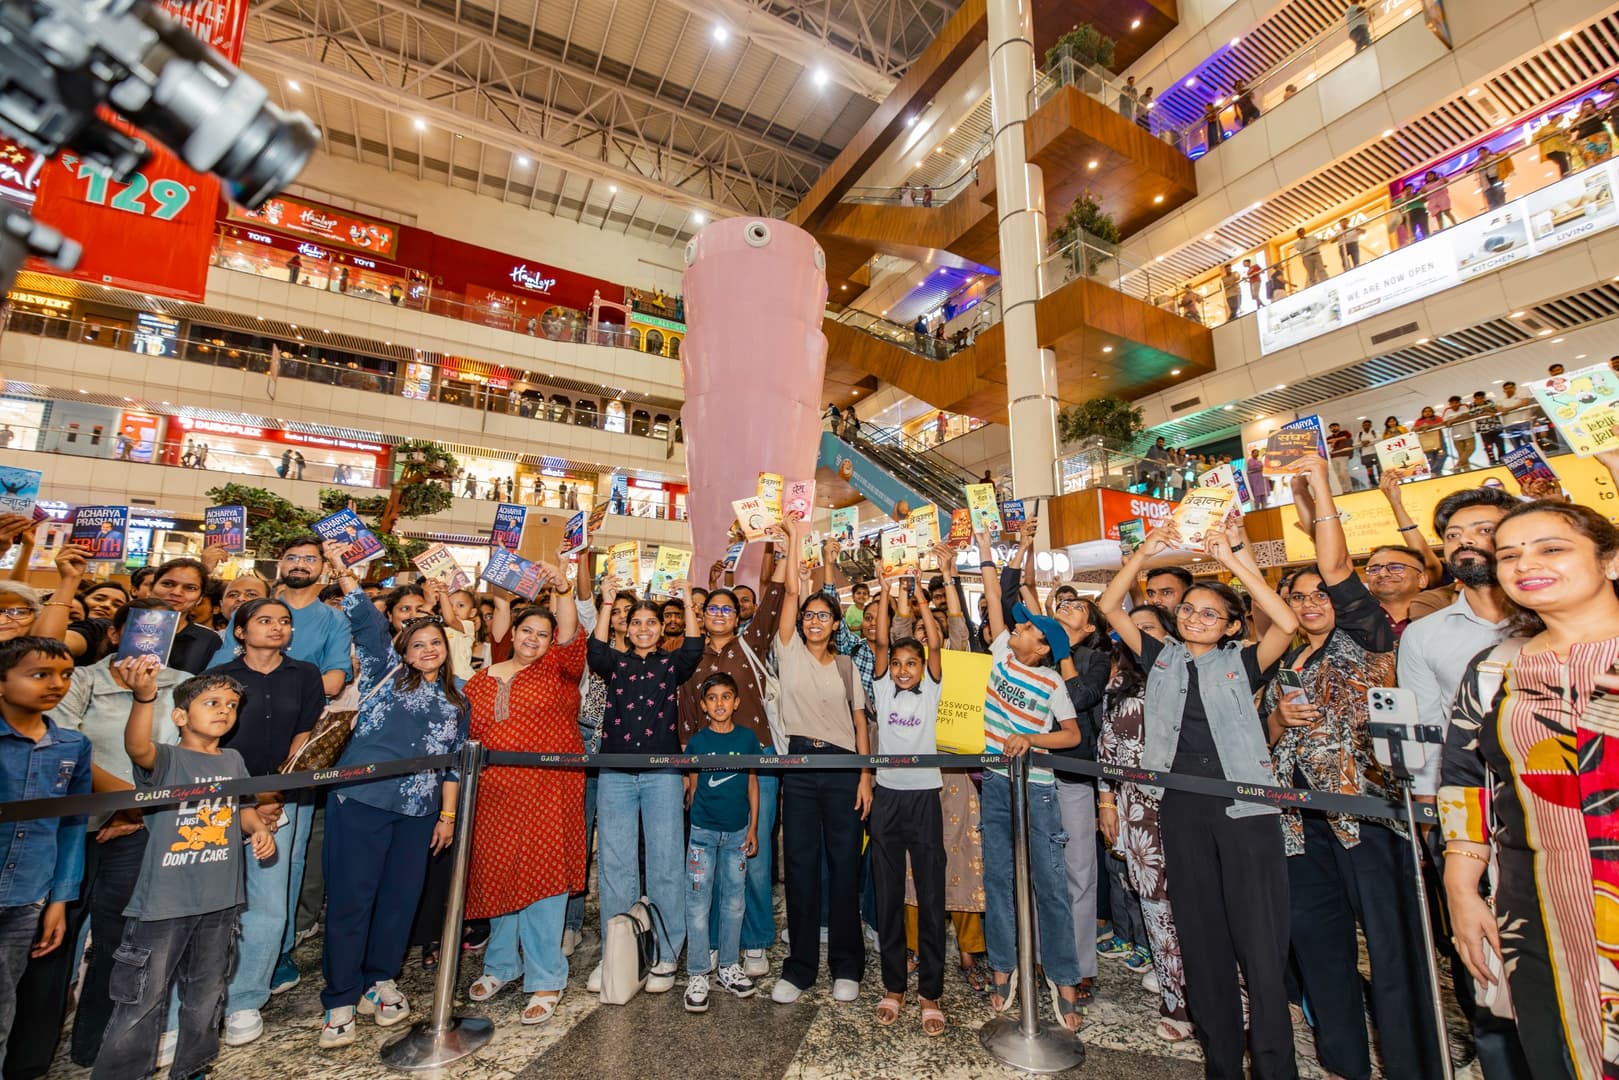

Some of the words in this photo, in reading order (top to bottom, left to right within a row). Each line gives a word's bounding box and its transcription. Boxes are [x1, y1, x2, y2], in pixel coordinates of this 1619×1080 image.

[300, 210, 338, 229] Hamleys
[247, 231, 272, 244] TOYS
[1557, 222, 1594, 241] LIVING
[353, 257, 376, 268] TOYS
[1471, 252, 1515, 273] KITCHEN
[509, 264, 556, 292] Hamleys
[1363, 282, 1380, 296] ARE
[1384, 273, 1405, 288] NOW
[1408, 262, 1435, 278] OPEN
[195, 420, 263, 437] DUROFLEX
[77, 509, 120, 518] ACHARYA
[207, 510, 238, 518] ACHARYA
[498, 506, 522, 516] ACHARYA
[75, 518, 126, 527] PRASHANT
[206, 516, 240, 525] PRASHANT
[317, 513, 352, 534] ACHARYA
[322, 517, 361, 540] PRASHANT
[206, 533, 241, 546] TRUTH
[486, 553, 508, 581] ACHARYA
[996, 686, 1026, 709] Royce
[937, 708, 953, 717] KES
[955, 711, 969, 719] ME
[938, 700, 982, 714] OSSWORD
[887, 712, 922, 727] Smile
[936, 717, 954, 726] PPY!
[649, 756, 670, 764] GAUR
[759, 756, 780, 764] GAUR
[869, 756, 890, 764] GAUR
[980, 755, 1001, 763] GAUR
[313, 770, 339, 781] GAUR
[1103, 766, 1124, 777] GAUR
[134, 789, 171, 801] GAUR
[171, 788, 190, 801] City
[190, 785, 207, 796] Mall
[1236, 785, 1265, 797] GAUR
[1265, 790, 1282, 803] City
[1280, 792, 1297, 801] Mall
[176, 817, 180, 826] I
[181, 817, 200, 826] JUST
[162, 850, 200, 867] DON'T
[200, 847, 230, 863] CARE
